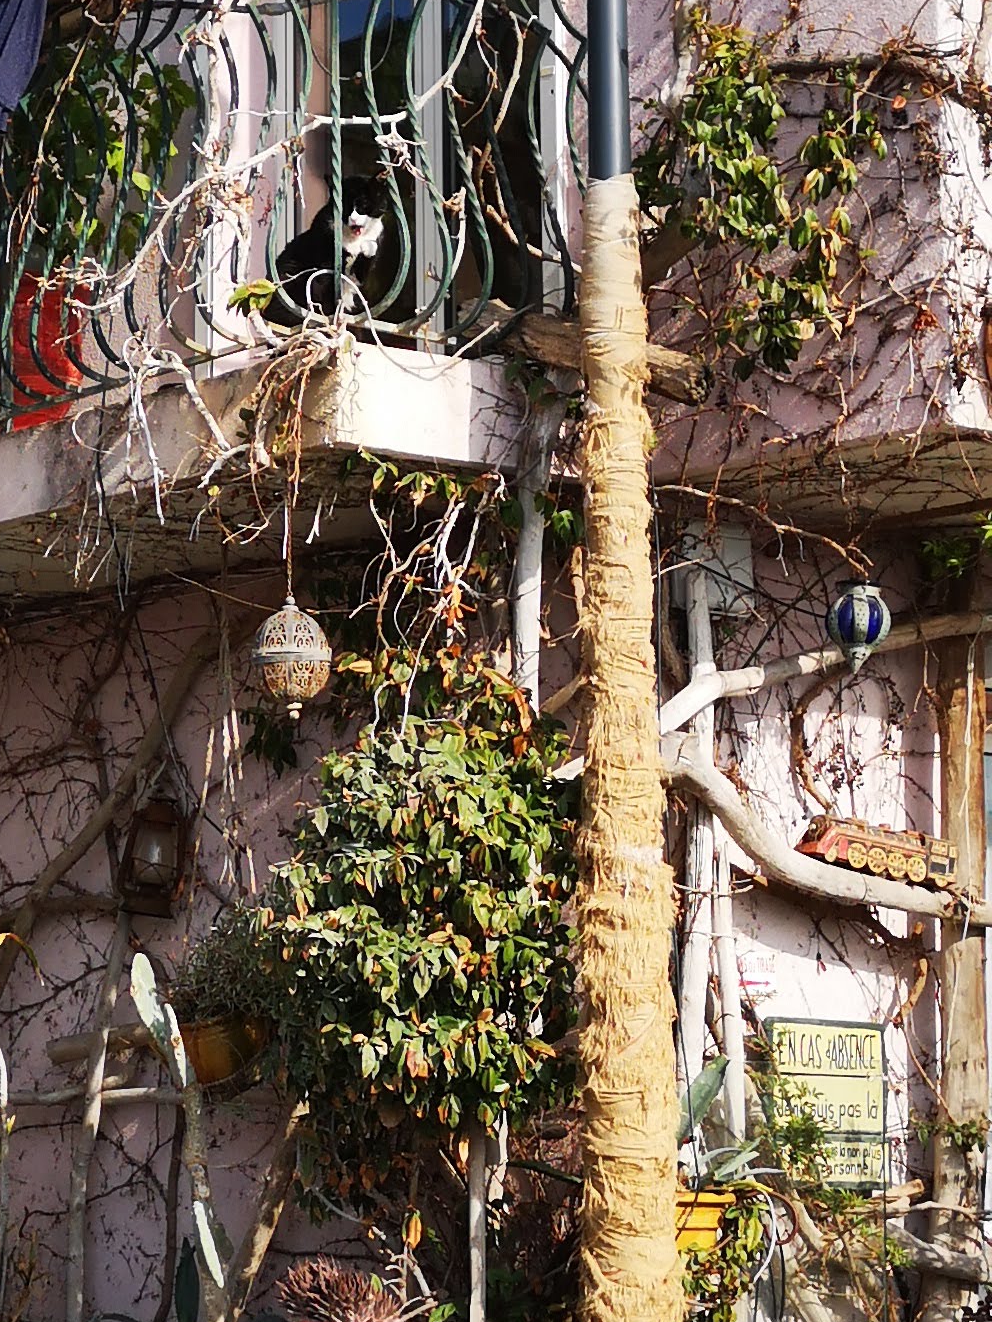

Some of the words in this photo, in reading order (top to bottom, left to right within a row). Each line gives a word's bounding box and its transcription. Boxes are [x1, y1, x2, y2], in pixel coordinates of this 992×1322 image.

[800, 1033, 822, 1069] CAS
[825, 1033, 877, 1070] d'ABSENCE
[839, 1103, 862, 1128] pas
[867, 1090, 879, 1119] là
[862, 1142, 882, 1161] plus
